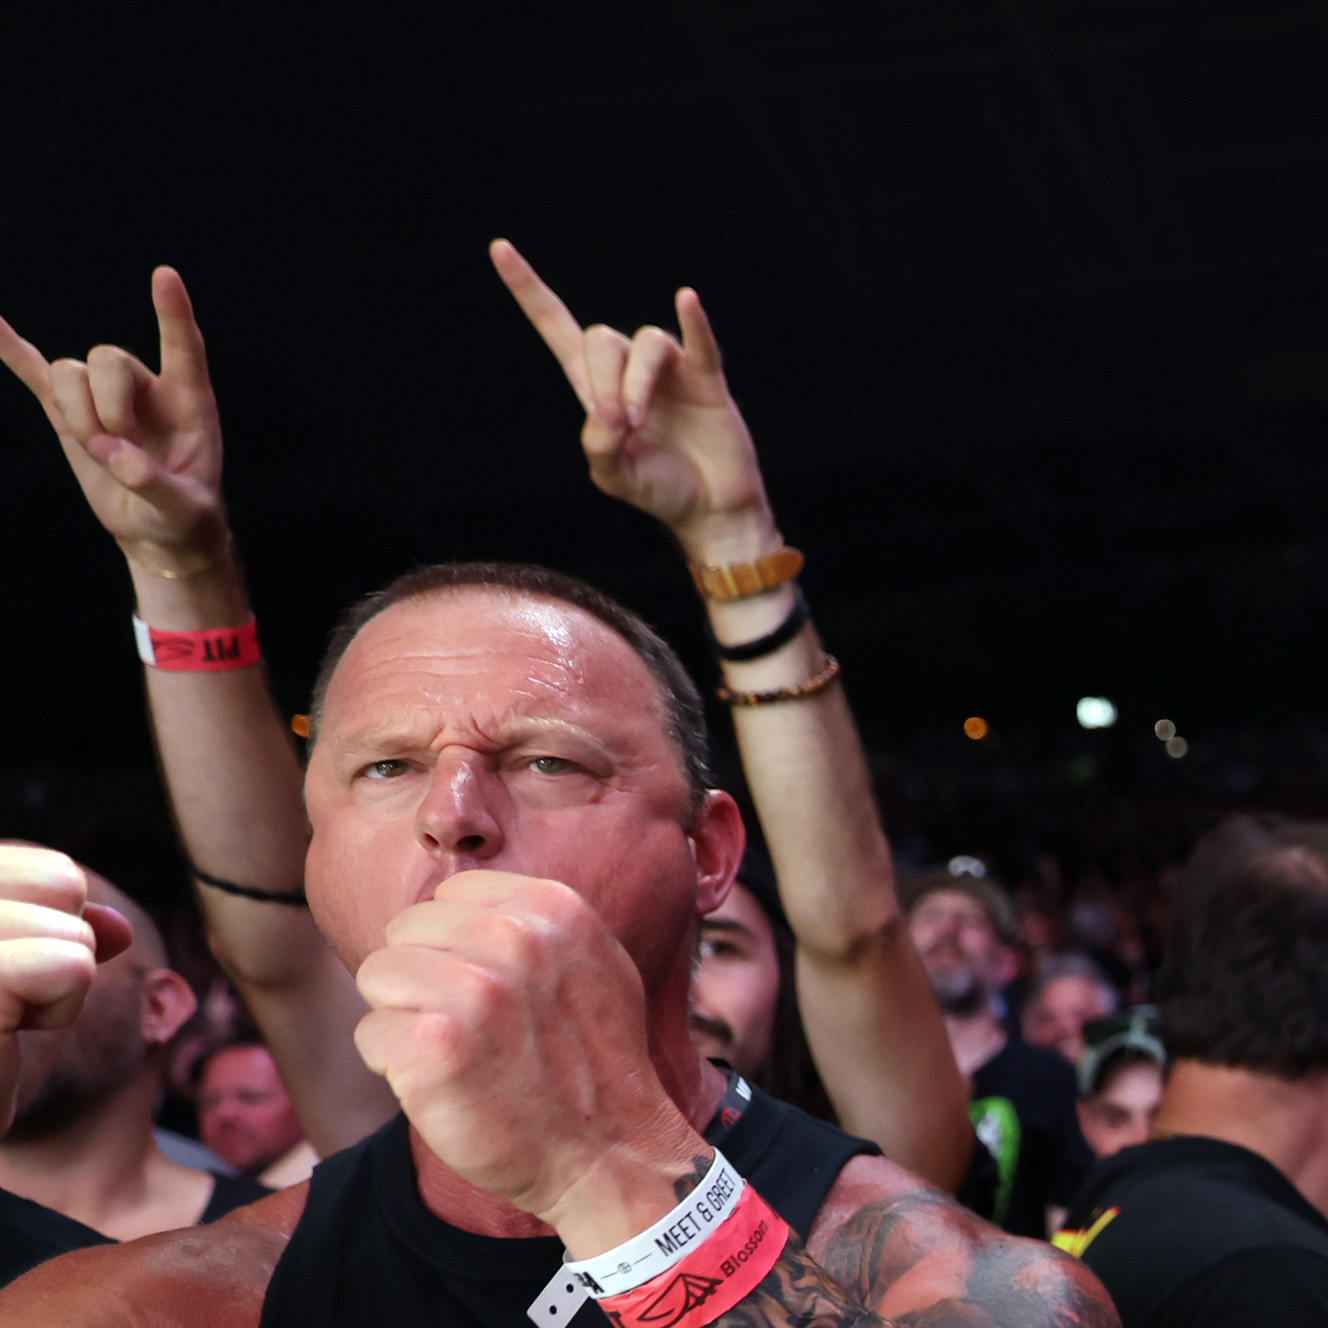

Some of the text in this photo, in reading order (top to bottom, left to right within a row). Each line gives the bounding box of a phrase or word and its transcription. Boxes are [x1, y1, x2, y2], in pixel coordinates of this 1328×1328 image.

[654, 1168, 737, 1258] MEET & GREET
[719, 1219, 769, 1279] Blossom
